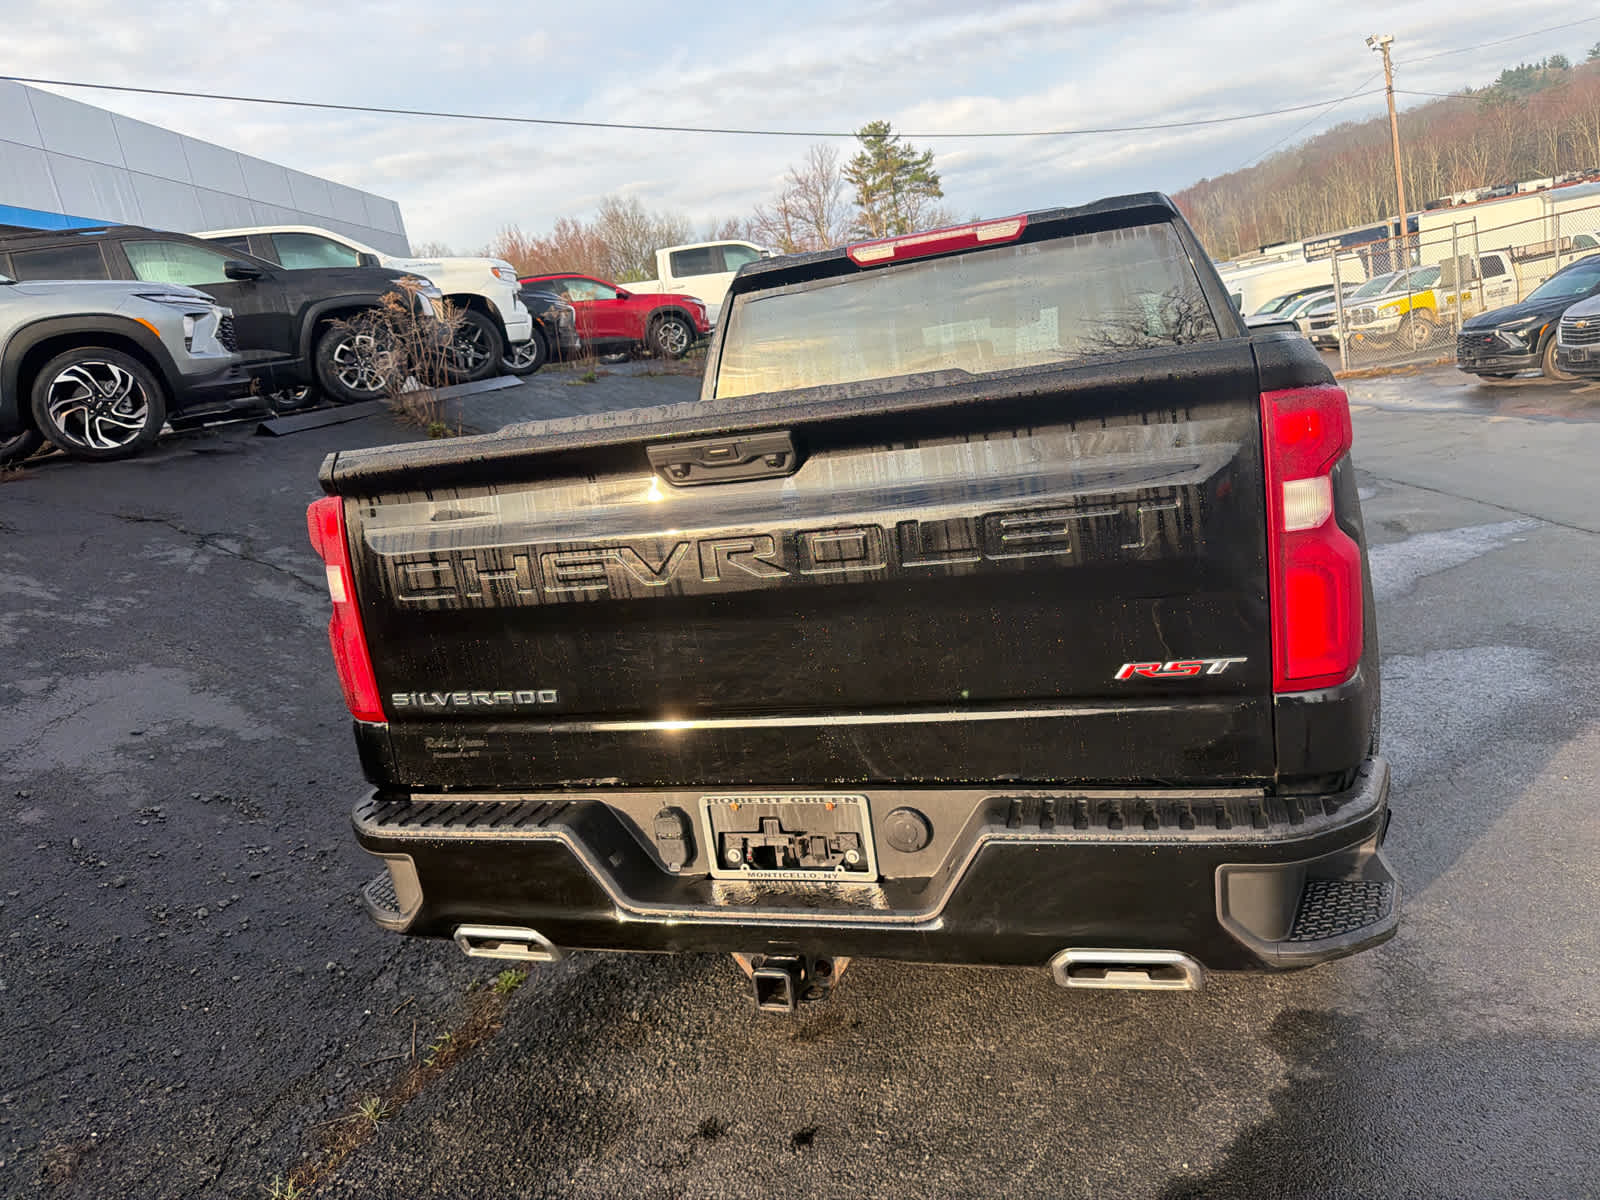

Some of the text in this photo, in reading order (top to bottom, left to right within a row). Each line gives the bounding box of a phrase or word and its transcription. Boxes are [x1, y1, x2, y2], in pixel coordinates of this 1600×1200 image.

[394, 496, 1183, 602] CHEVROLET
[1114, 657, 1248, 680] RST
[391, 690, 558, 706] SILVERADO
[706, 797, 784, 805] ROBERT
